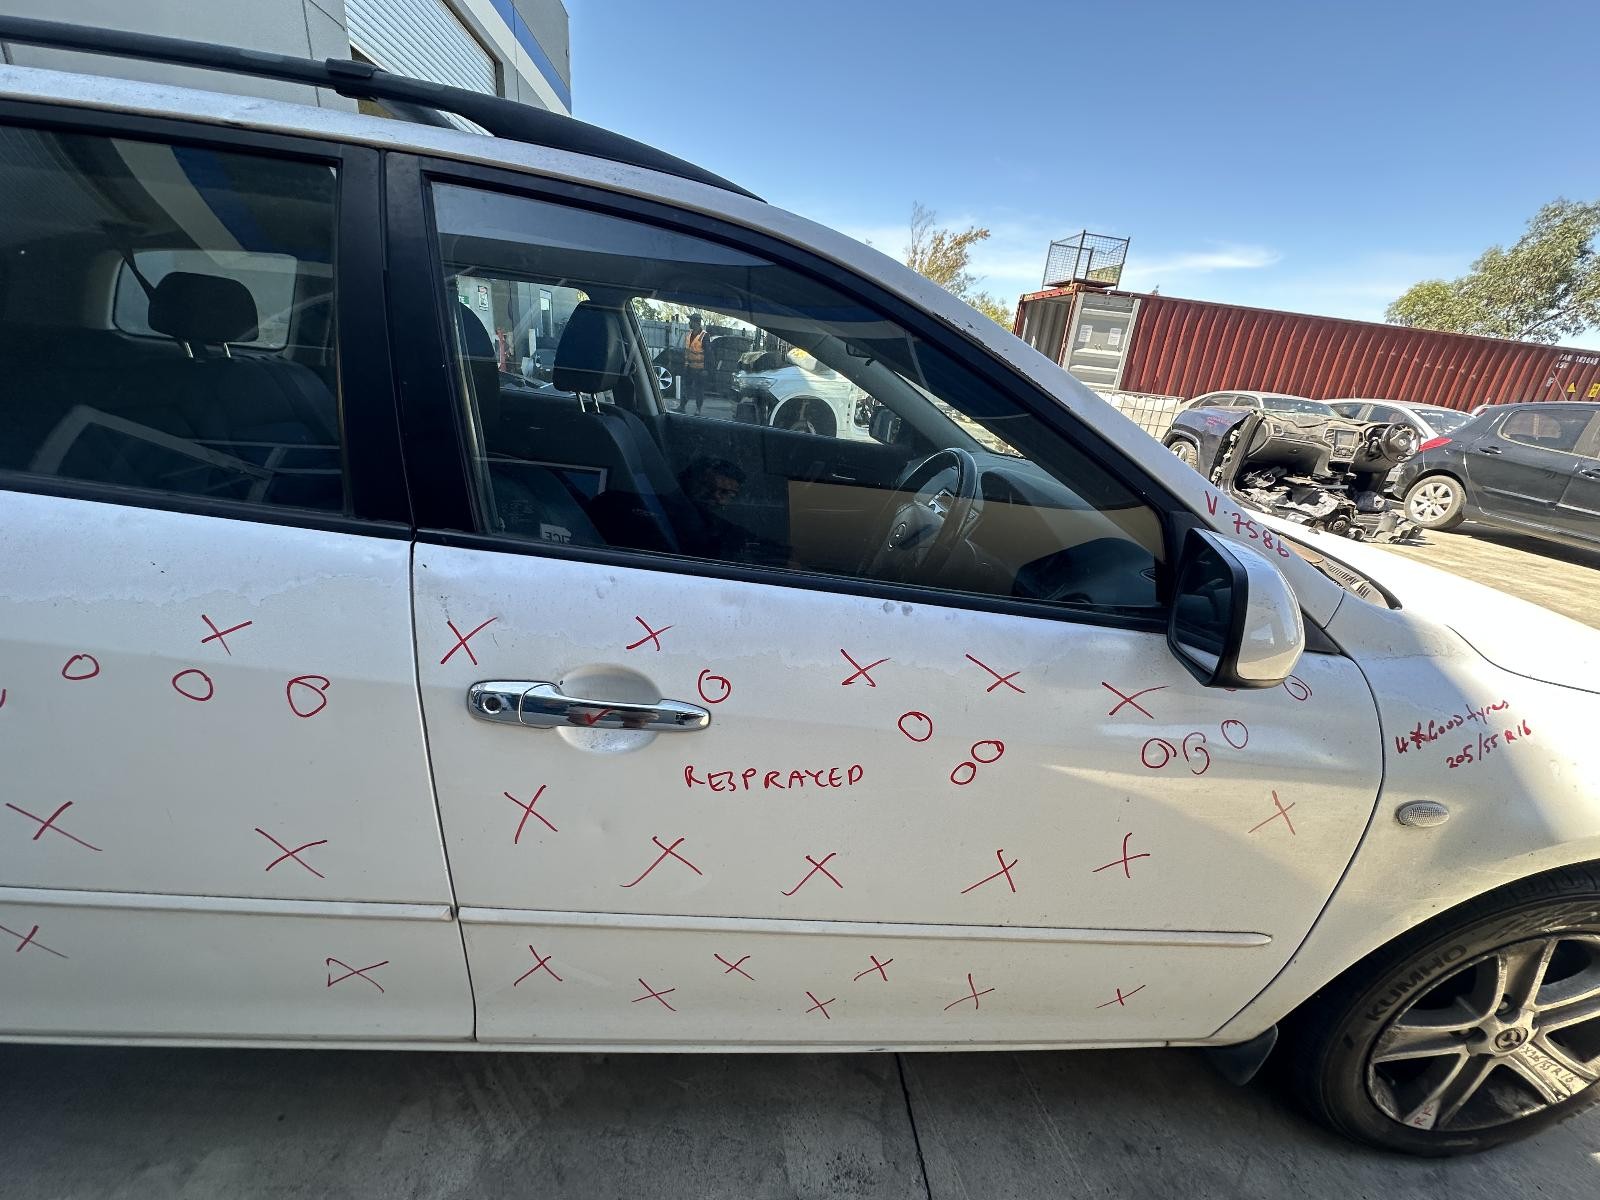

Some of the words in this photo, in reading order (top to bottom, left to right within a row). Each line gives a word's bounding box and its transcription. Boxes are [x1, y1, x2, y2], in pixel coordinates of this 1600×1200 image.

[1446, 732, 1499, 768] 205/55
[684, 764, 864, 793] RESPRAYED
[1365, 944, 1468, 1022] KUMHO
